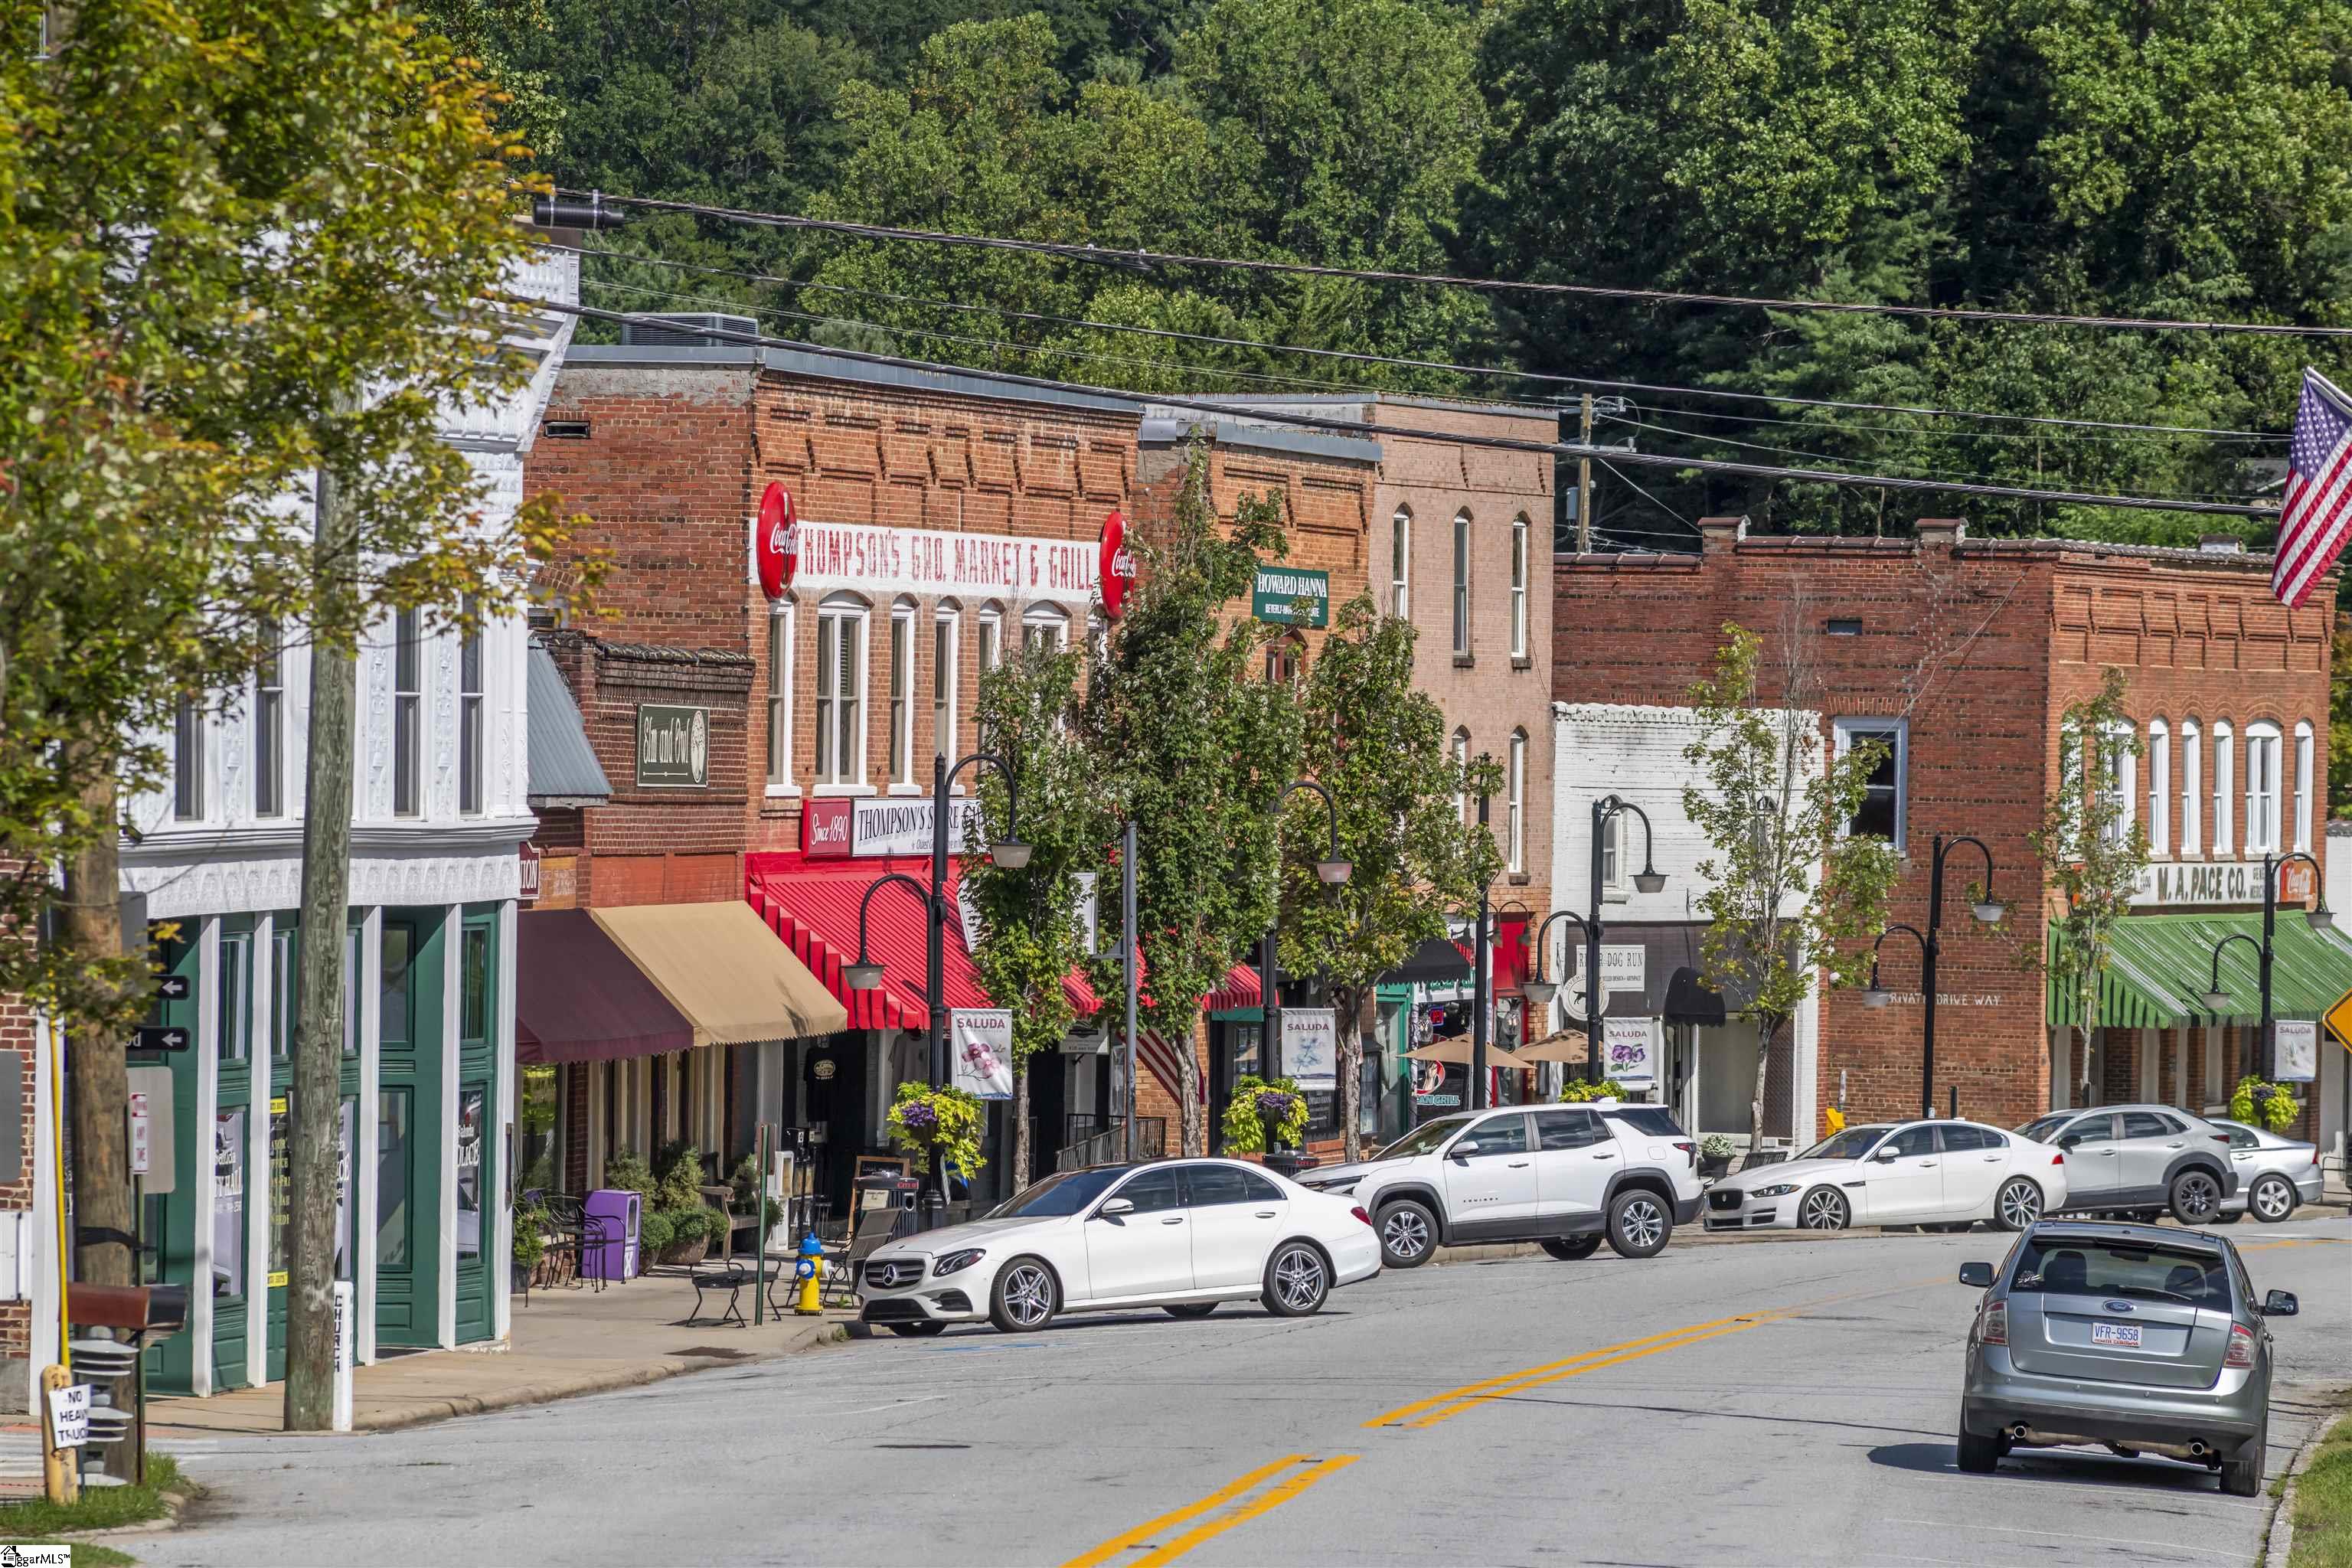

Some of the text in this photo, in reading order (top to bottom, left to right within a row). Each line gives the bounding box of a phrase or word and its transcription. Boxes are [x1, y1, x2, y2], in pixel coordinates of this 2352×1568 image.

[955, 538, 1021, 587] MARKET
[1049, 545, 1093, 590] GRILL
[1257, 573, 1328, 598] HOWARD HANNA
[659, 717, 674, 764] and
[812, 813, 848, 845] Since 1890
[858, 805, 925, 841] THOMPSON'S
[927, 805, 959, 830] SRE
[521, 859, 538, 889] ION
[2191, 866, 2223, 901] PACE
[2228, 866, 2246, 900] CO.
[1607, 952, 1623, 967] DOG
[1627, 952, 1643, 967] RUN
[1890, 992, 2001, 1005] RIVAT DRIVE WAY
[957, 1018, 1005, 1030] SALUDA
[1434, 1096, 1459, 1105] GRILL
[2095, 1325, 2138, 1341] VFR-9658
[67, 1390, 82, 1403] NO
